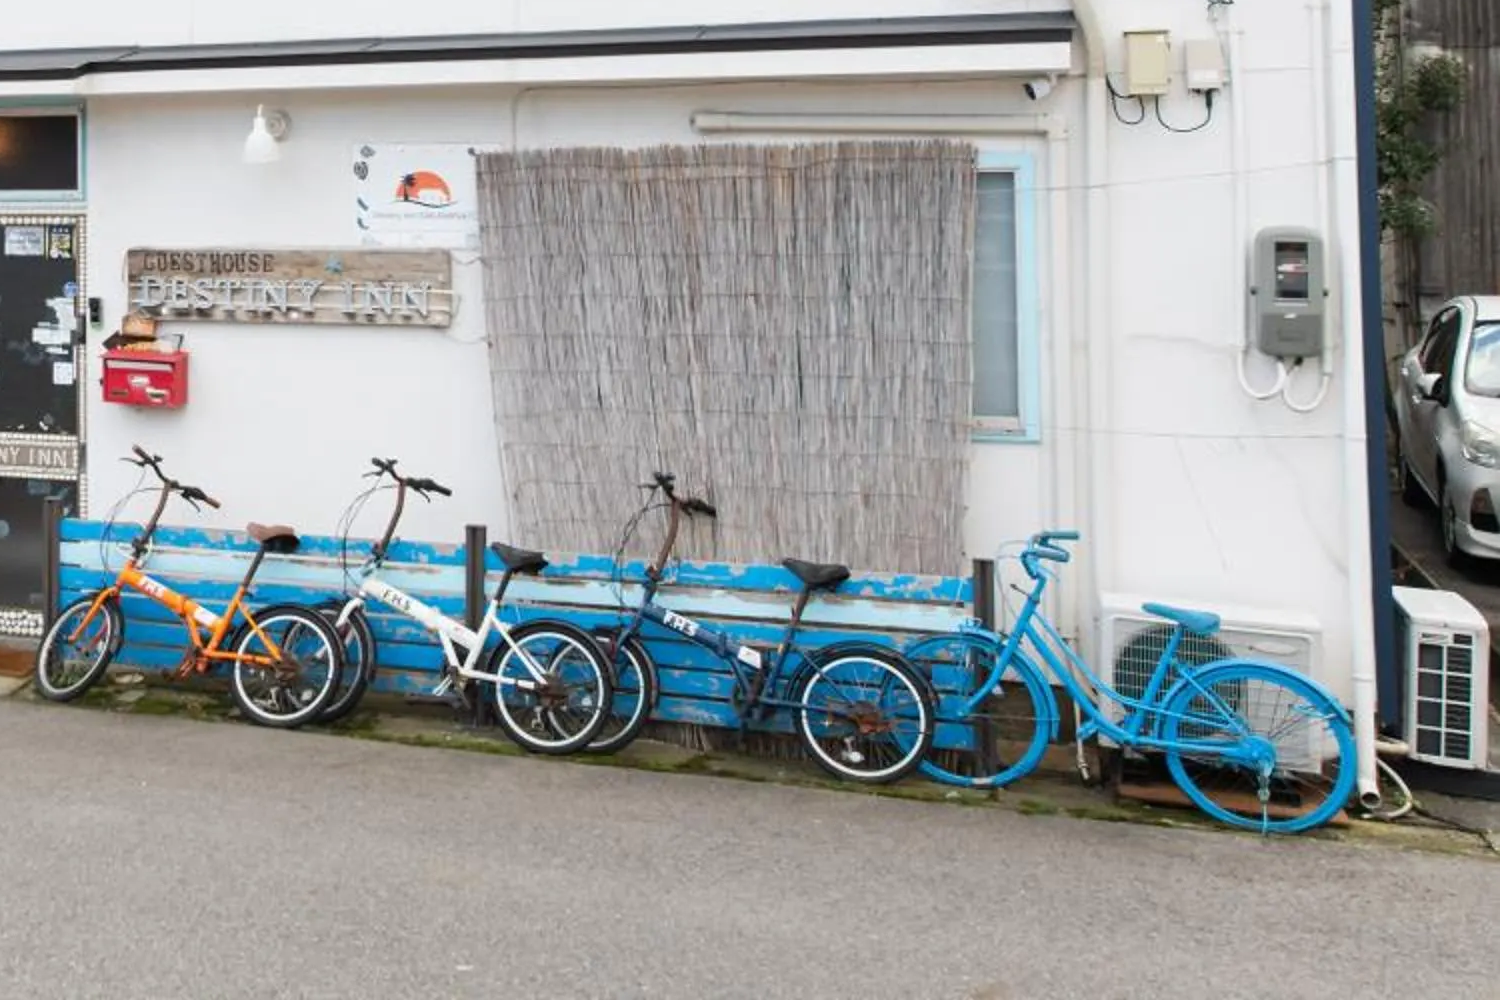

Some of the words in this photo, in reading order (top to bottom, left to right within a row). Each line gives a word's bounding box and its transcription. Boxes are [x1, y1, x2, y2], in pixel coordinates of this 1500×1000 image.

[143, 252, 276, 273] GUESTHOUSE
[137, 275, 324, 313] DESTINY
[343, 280, 432, 317] INN
[29, 447, 67, 467] INN
